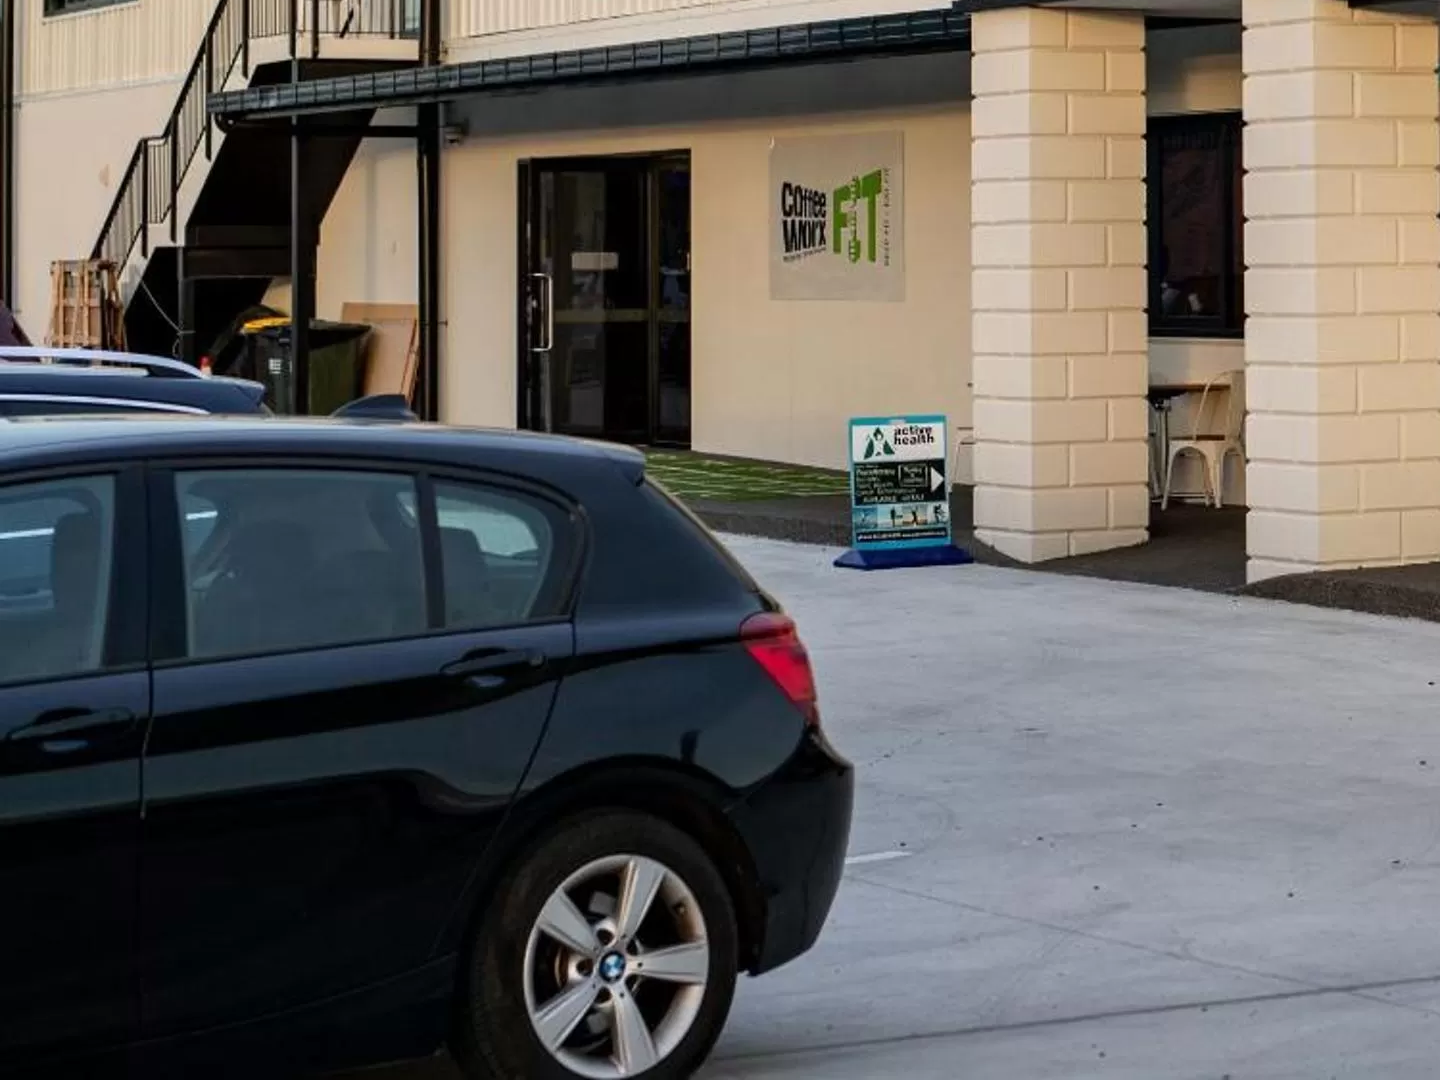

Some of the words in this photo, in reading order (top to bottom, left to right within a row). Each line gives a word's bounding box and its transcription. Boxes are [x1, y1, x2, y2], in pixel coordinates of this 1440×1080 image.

[833, 168, 882, 263] FIT
[894, 425, 933, 436] active
[894, 433, 934, 446] health
